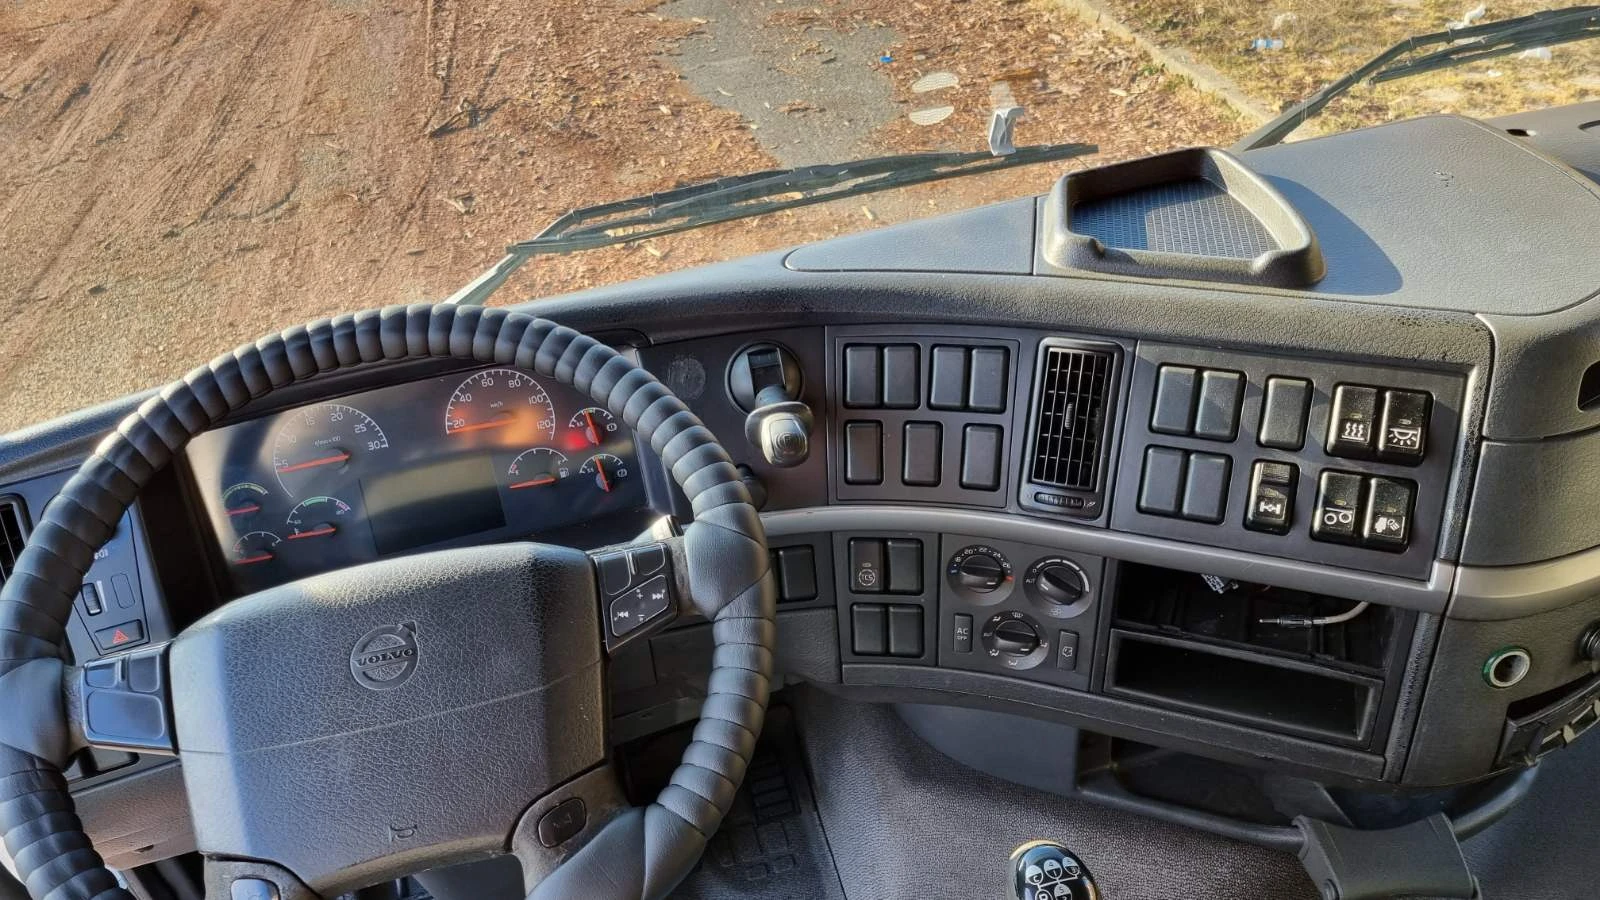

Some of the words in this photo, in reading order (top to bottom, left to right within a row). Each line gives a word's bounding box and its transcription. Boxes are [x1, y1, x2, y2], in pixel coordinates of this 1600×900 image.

[481, 378, 494, 388] 60
[508, 378, 521, 388] 80
[460, 393, 472, 403] 40
[528, 394, 544, 405] 100
[331, 412, 344, 422] 20
[353, 423, 367, 434] 25
[453, 418, 465, 429] 20
[536, 420, 551, 431] 120
[368, 441, 380, 451] 30
[956, 627, 969, 635] AC
[354, 648, 414, 667] VOLVO
